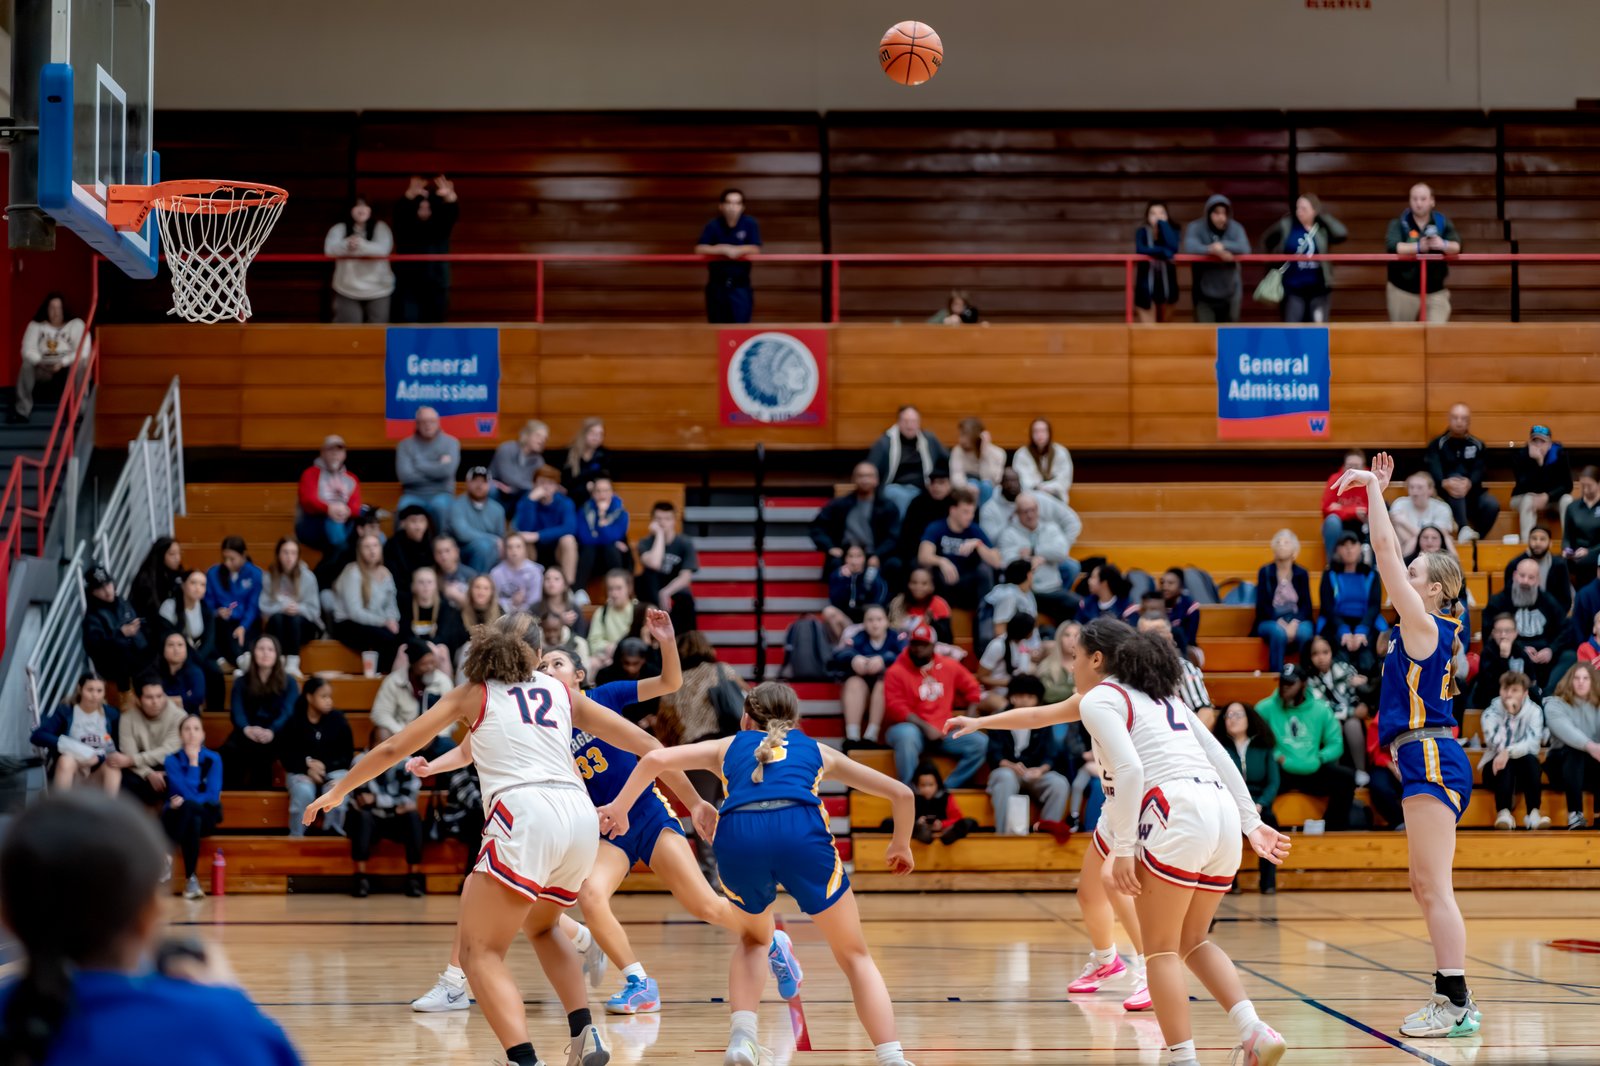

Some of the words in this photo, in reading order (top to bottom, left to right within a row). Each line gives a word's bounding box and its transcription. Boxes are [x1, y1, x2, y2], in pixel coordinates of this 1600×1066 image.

[407, 354, 478, 375] General
[1239, 353, 1308, 375] General
[396, 379, 488, 401] Admission
[1228, 379, 1319, 401] Admission
[476, 418, 494, 433] W
[1309, 418, 1326, 432] W
[507, 686, 558, 729] 12
[1155, 697, 1188, 731] 2
[575, 746, 609, 779] 33
[1138, 823, 1153, 841] W
